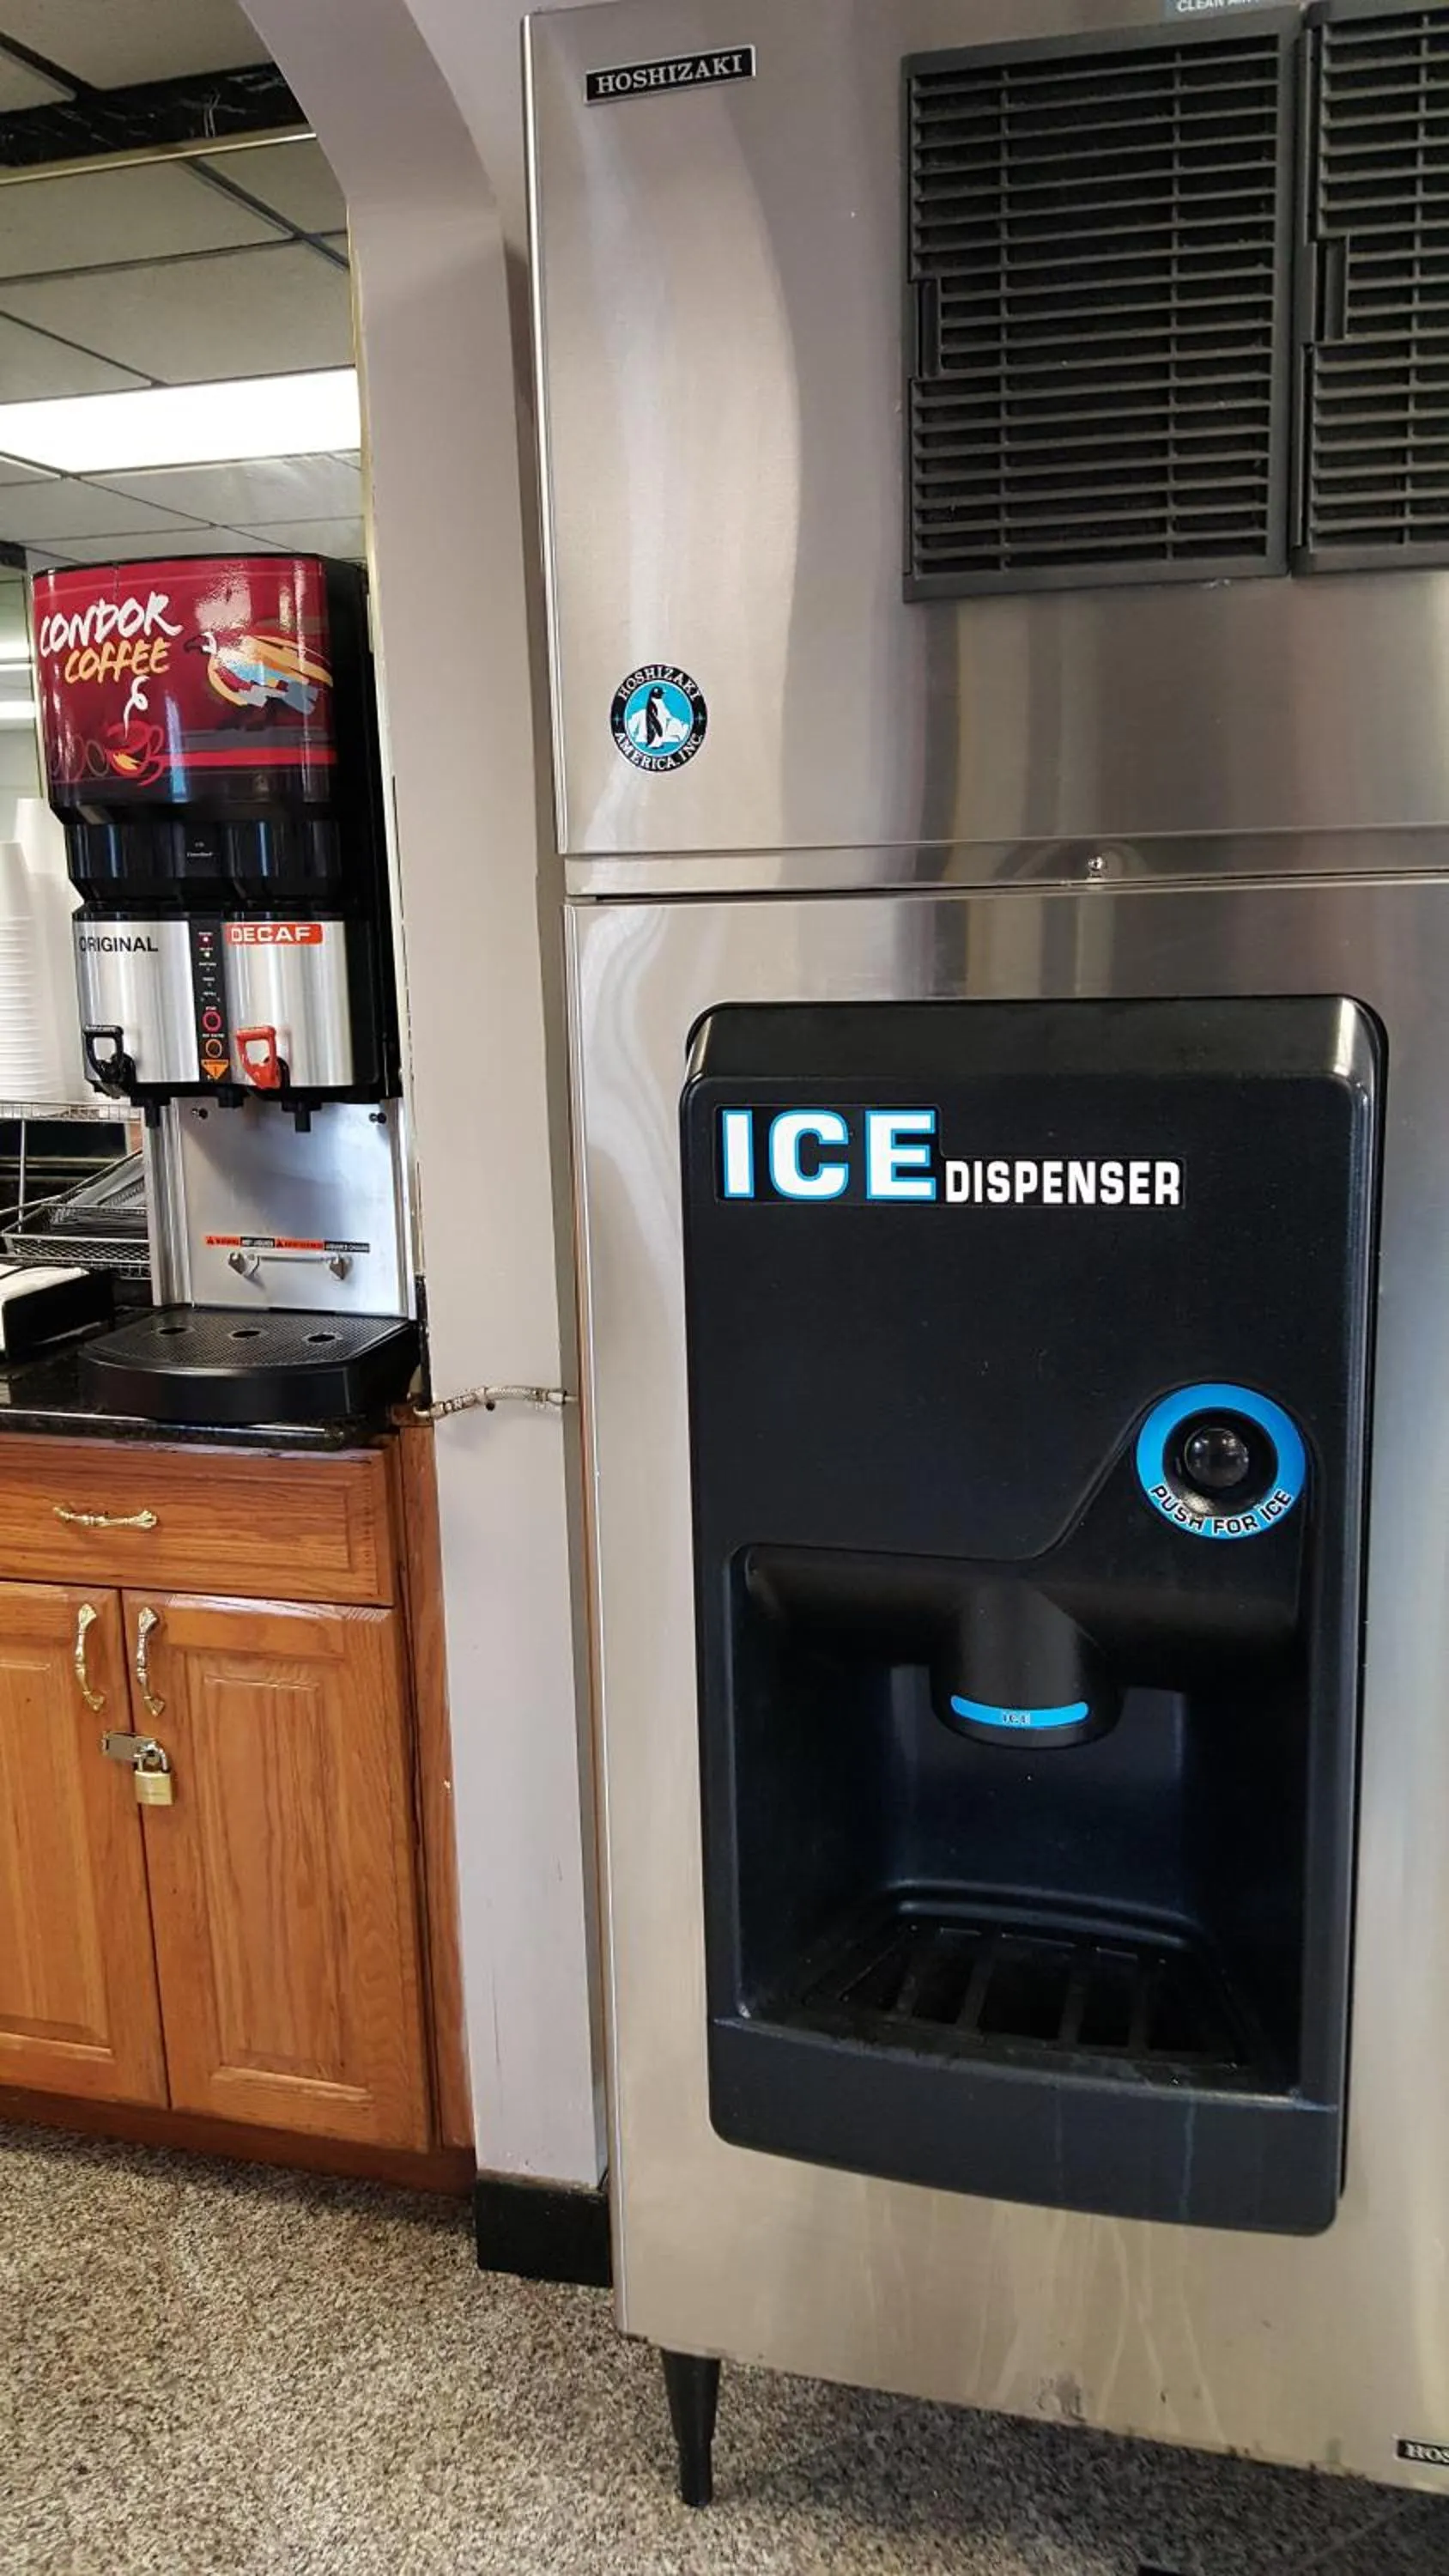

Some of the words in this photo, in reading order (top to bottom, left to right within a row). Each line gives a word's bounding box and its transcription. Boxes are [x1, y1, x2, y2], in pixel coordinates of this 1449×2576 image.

[596, 54, 743, 94] HOSHIZAKI
[39, 591, 183, 658] CONDOR
[64, 636, 172, 684] COFFEE
[618, 665, 701, 701] HOSHIZAKI
[79, 936, 159, 953] ORIGINAL
[230, 926, 312, 943] DECAF
[722, 1109, 937, 1200] ICE
[945, 1160, 1182, 1206] DISPENSER
[1150, 1485, 1203, 1530] PUSH
[1213, 1516, 1258, 1535] FOR
[1260, 1489, 1293, 1522] ICE
